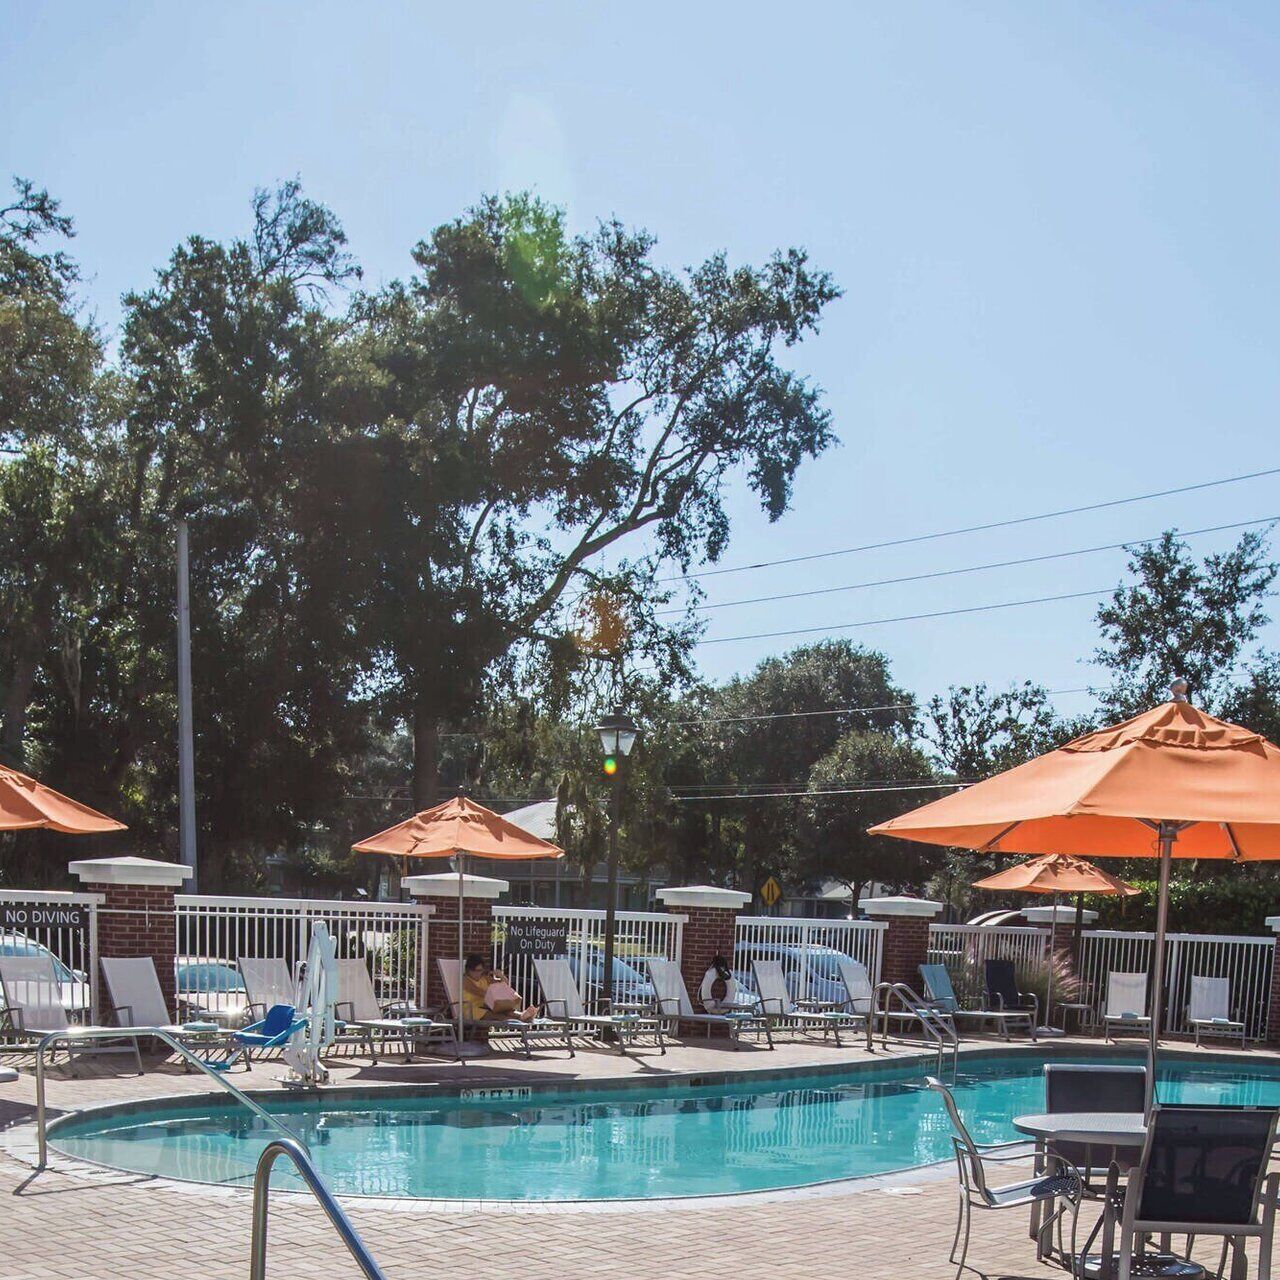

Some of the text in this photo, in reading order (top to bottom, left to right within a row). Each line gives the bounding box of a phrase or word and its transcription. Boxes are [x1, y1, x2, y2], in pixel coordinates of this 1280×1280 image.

[6, 910, 80, 924] NO DIVING
[510, 925, 565, 939] No Lifeguard
[520, 938, 556, 952] On Duty
